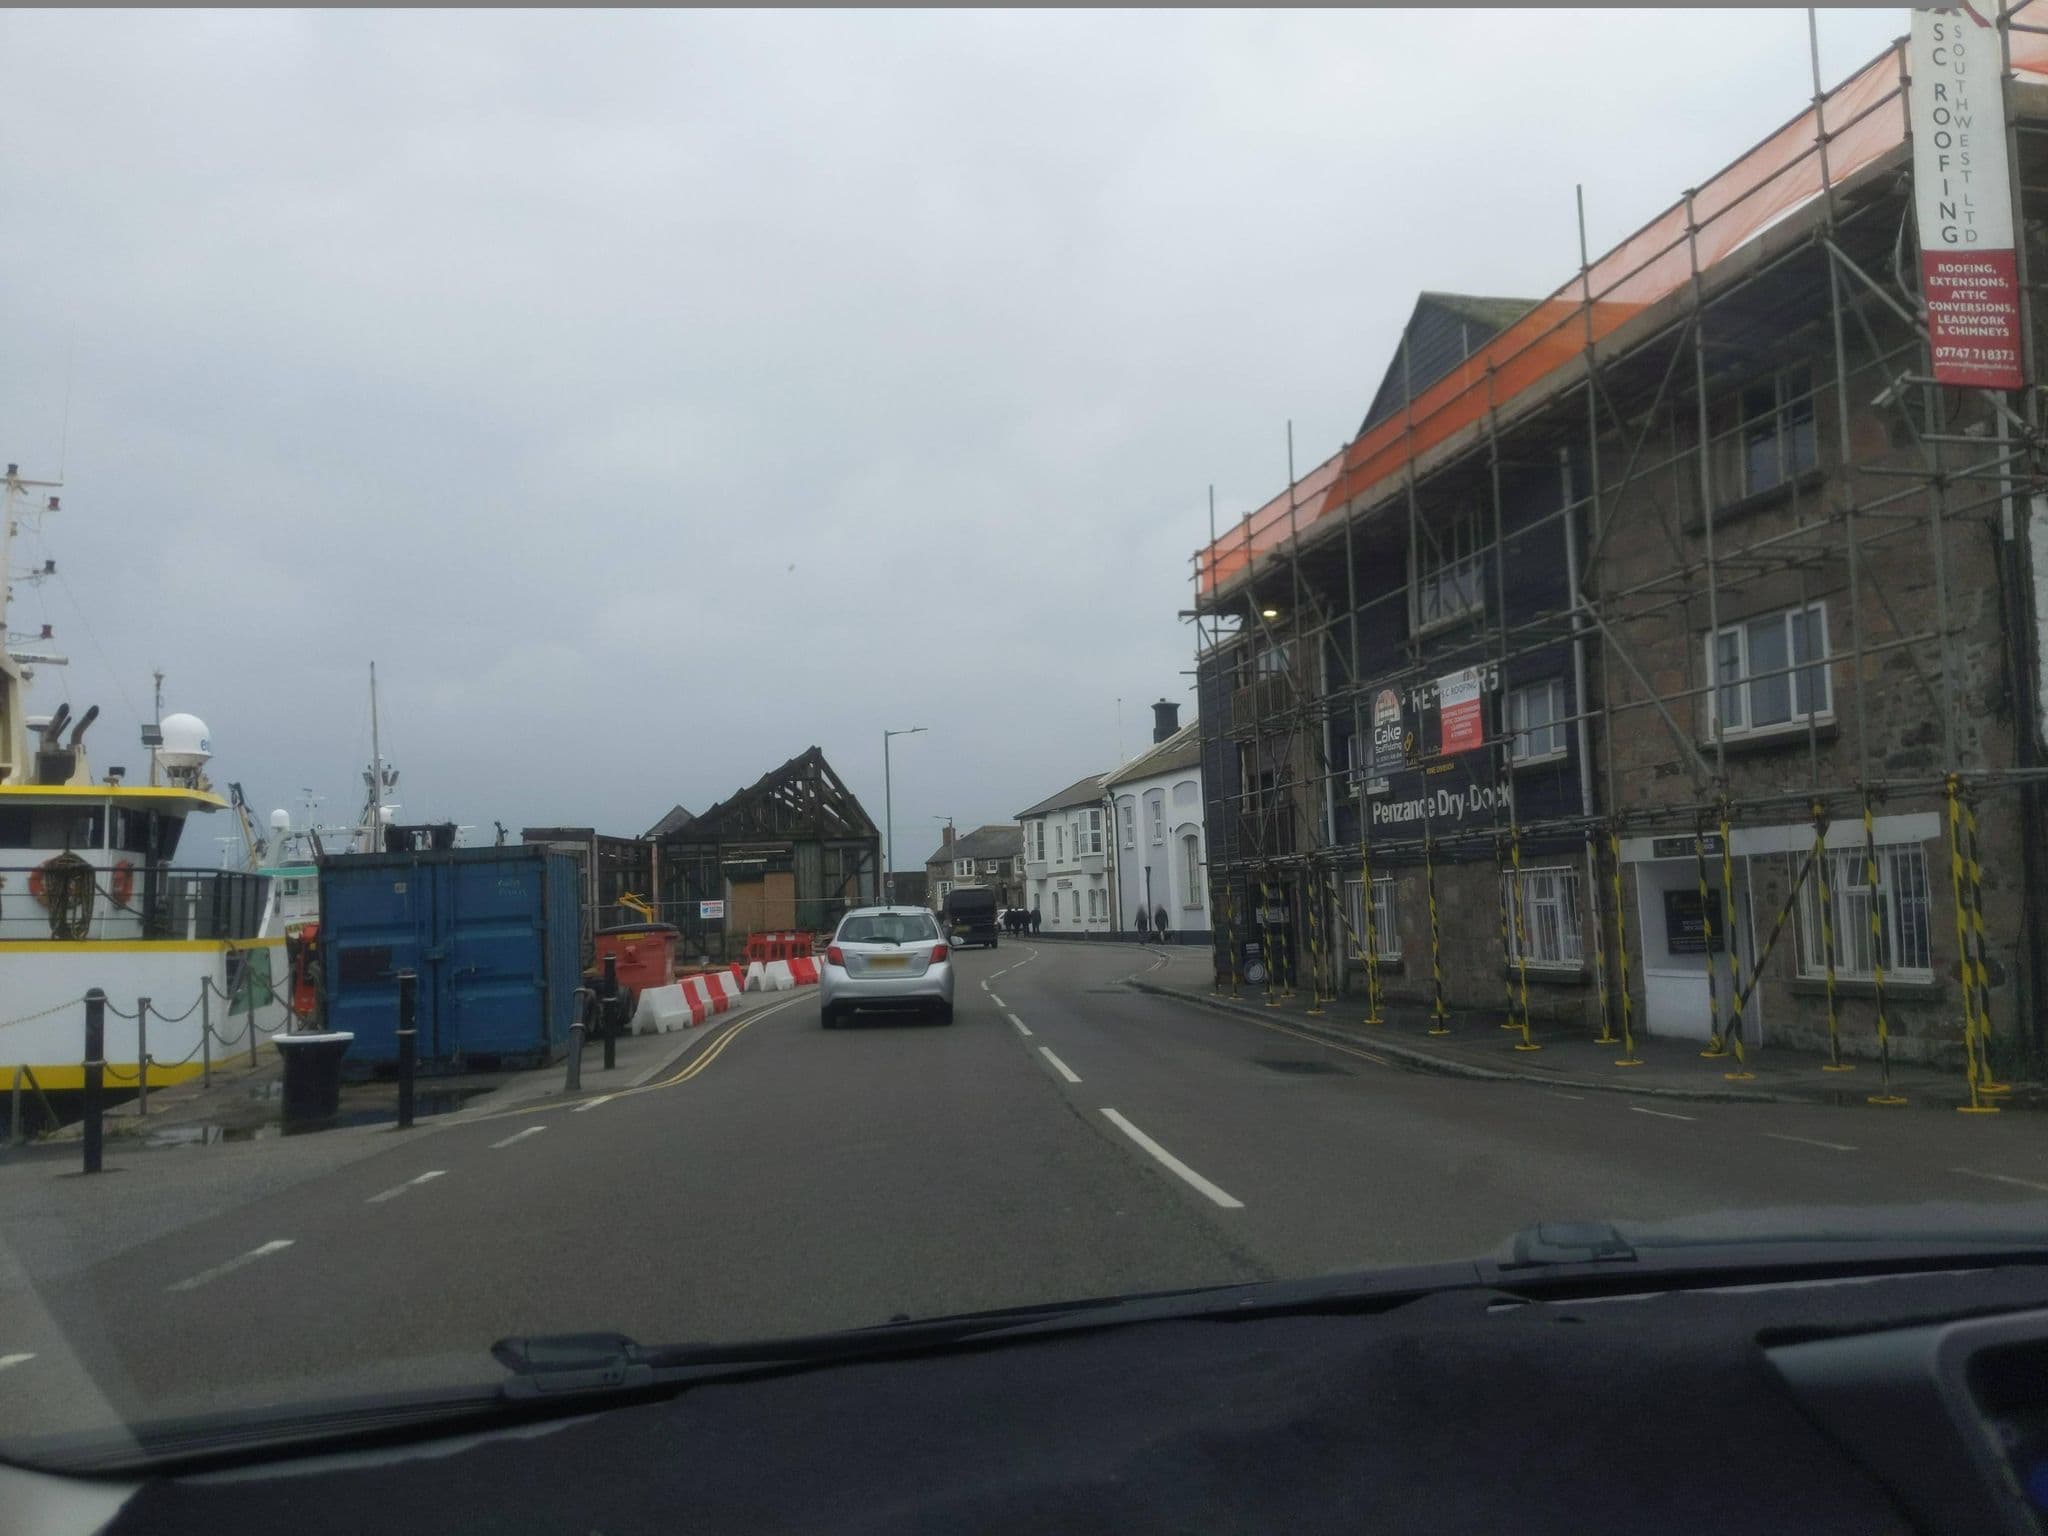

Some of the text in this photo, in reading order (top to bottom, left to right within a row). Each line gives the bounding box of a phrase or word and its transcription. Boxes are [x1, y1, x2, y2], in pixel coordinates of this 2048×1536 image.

[1953, 25, 1978, 243] SOUTHWEST LTD
[1932, 83, 1958, 244] ROOFING
[1938, 264, 1996, 274] ROOFING,
[1929, 276, 2009, 288] EXTENSIONS,
[1951, 290, 1988, 300] ATTIC
[1937, 314, 2006, 325] LEADWORK
[1937, 326, 2010, 337] & CHIMNEYS
[1935, 346, 1970, 358] 07747
[1374, 724, 1402, 745] Cake
[1372, 797, 1436, 825] Penzance
